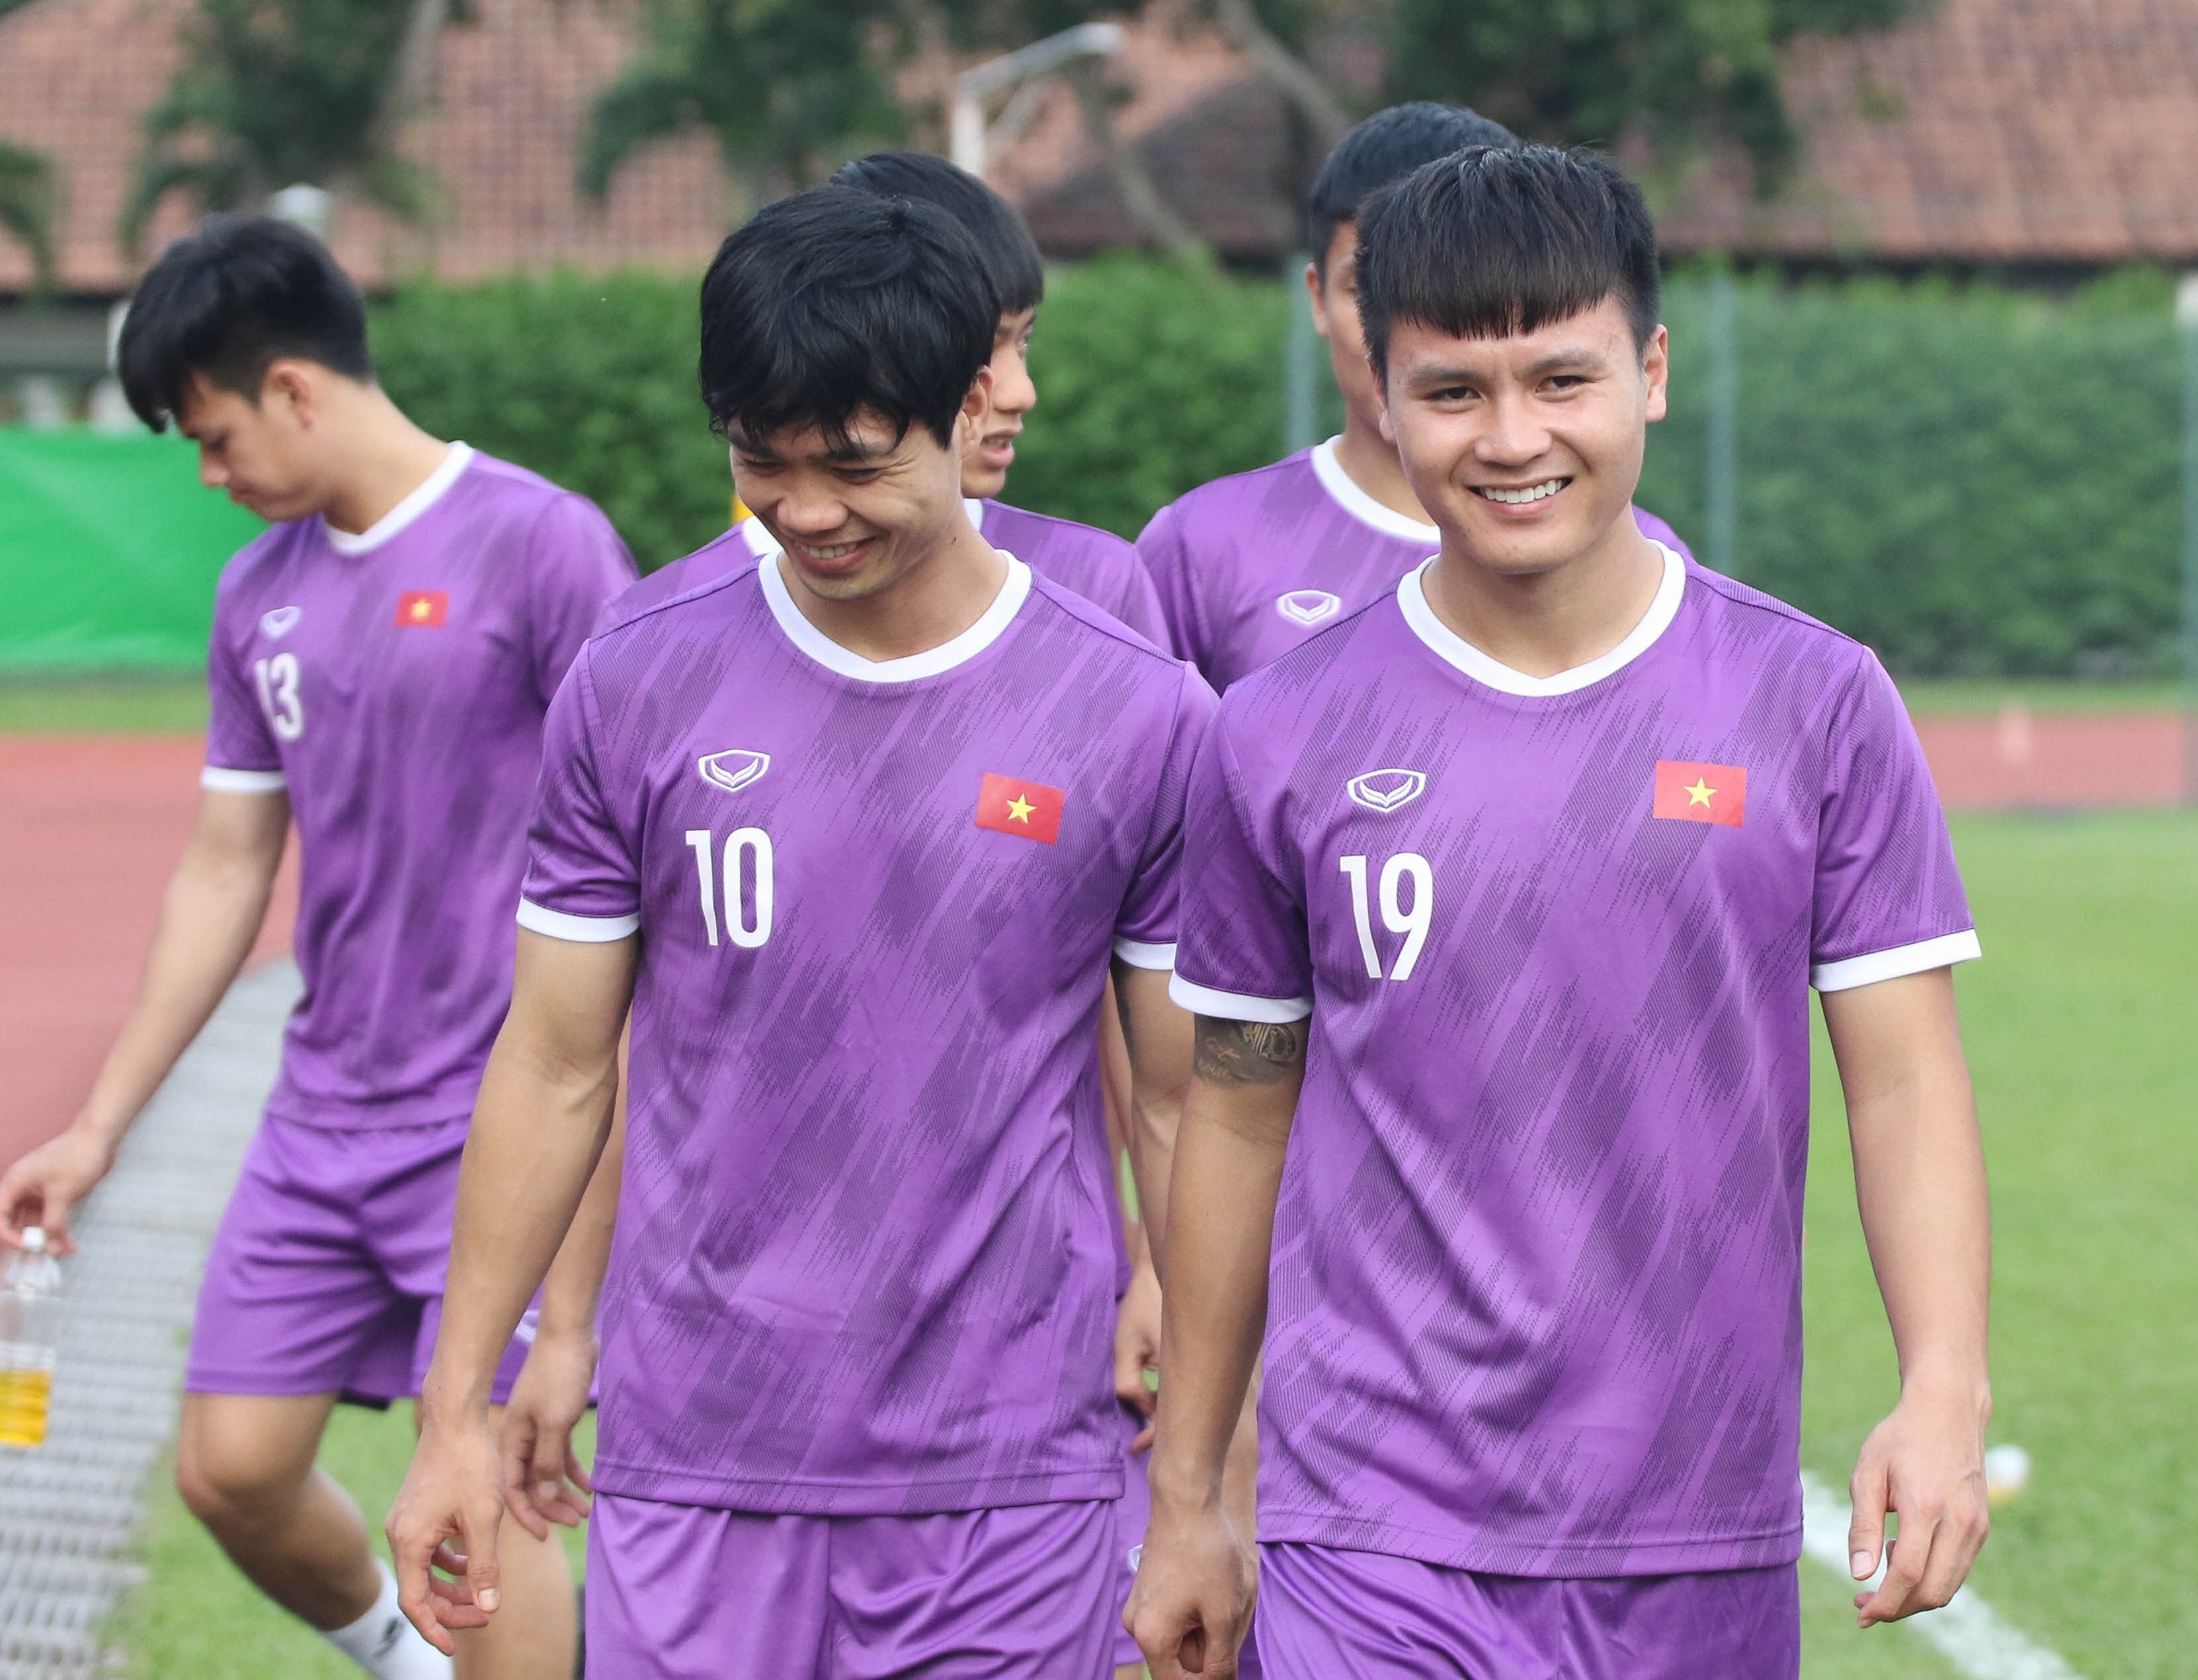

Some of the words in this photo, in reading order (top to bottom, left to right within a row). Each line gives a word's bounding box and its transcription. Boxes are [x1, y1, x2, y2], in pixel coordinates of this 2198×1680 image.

[255, 652, 304, 740] 13
[685, 827, 773, 947] 10
[1340, 852, 1434, 980] 19
